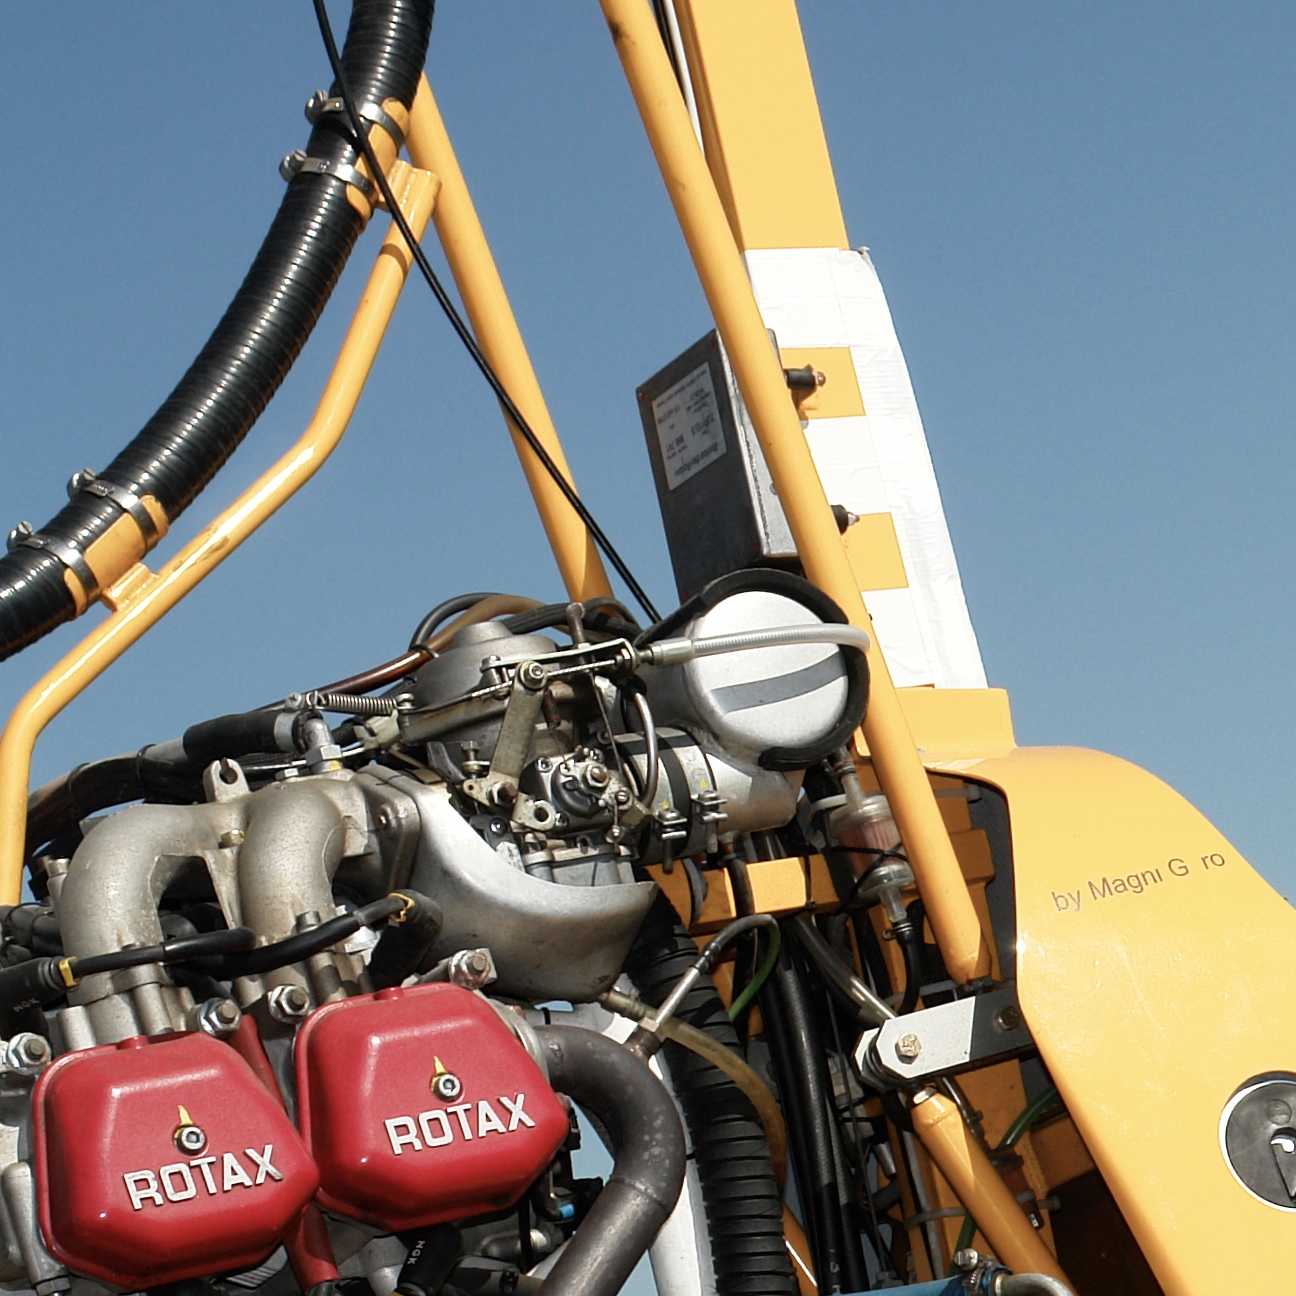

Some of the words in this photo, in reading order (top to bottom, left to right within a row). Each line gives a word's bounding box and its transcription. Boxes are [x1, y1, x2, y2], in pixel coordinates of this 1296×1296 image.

[1051, 889, 1081, 912] by
[1088, 867, 1163, 900] Magni
[12, 997, 41, 1013] NGK
[384, 1093, 536, 1155] ROTAX
[123, 1144, 284, 1210] ROTAX
[406, 1240, 426, 1265] NGK
